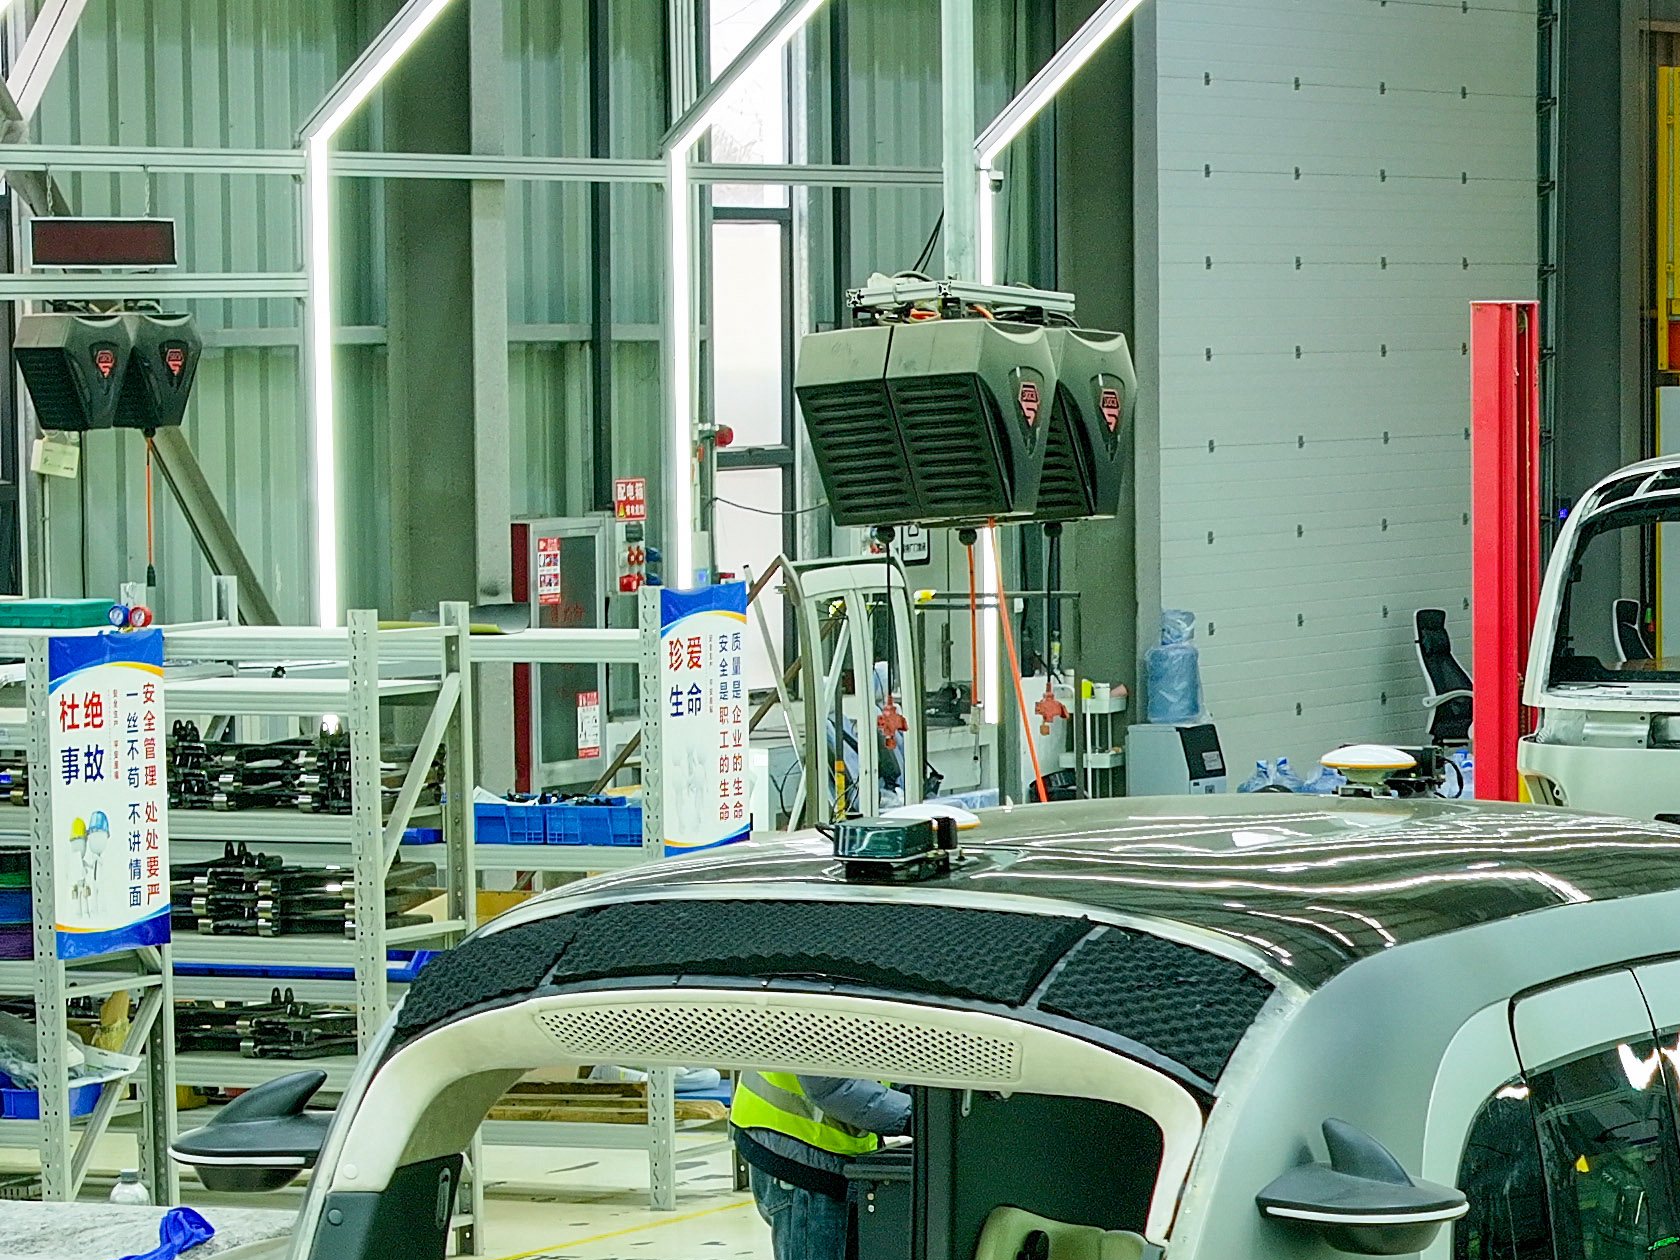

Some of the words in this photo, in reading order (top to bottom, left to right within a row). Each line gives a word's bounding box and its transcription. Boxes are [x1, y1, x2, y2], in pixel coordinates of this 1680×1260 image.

[668, 636, 702, 672] 珍爱
[668, 682, 702, 717] 生命
[59, 691, 104, 733] 杜绝
[126, 692, 140, 789] 一丝不苟
[142, 682, 157, 787] 安全管理
[718, 634, 731, 821] 安全是职工的生命
[731, 632, 744, 819] 质量是企业的生命
[60, 744, 105, 786] 事故
[128, 803, 142, 908] 不讲情面
[145, 800, 160, 906] 处处要严
